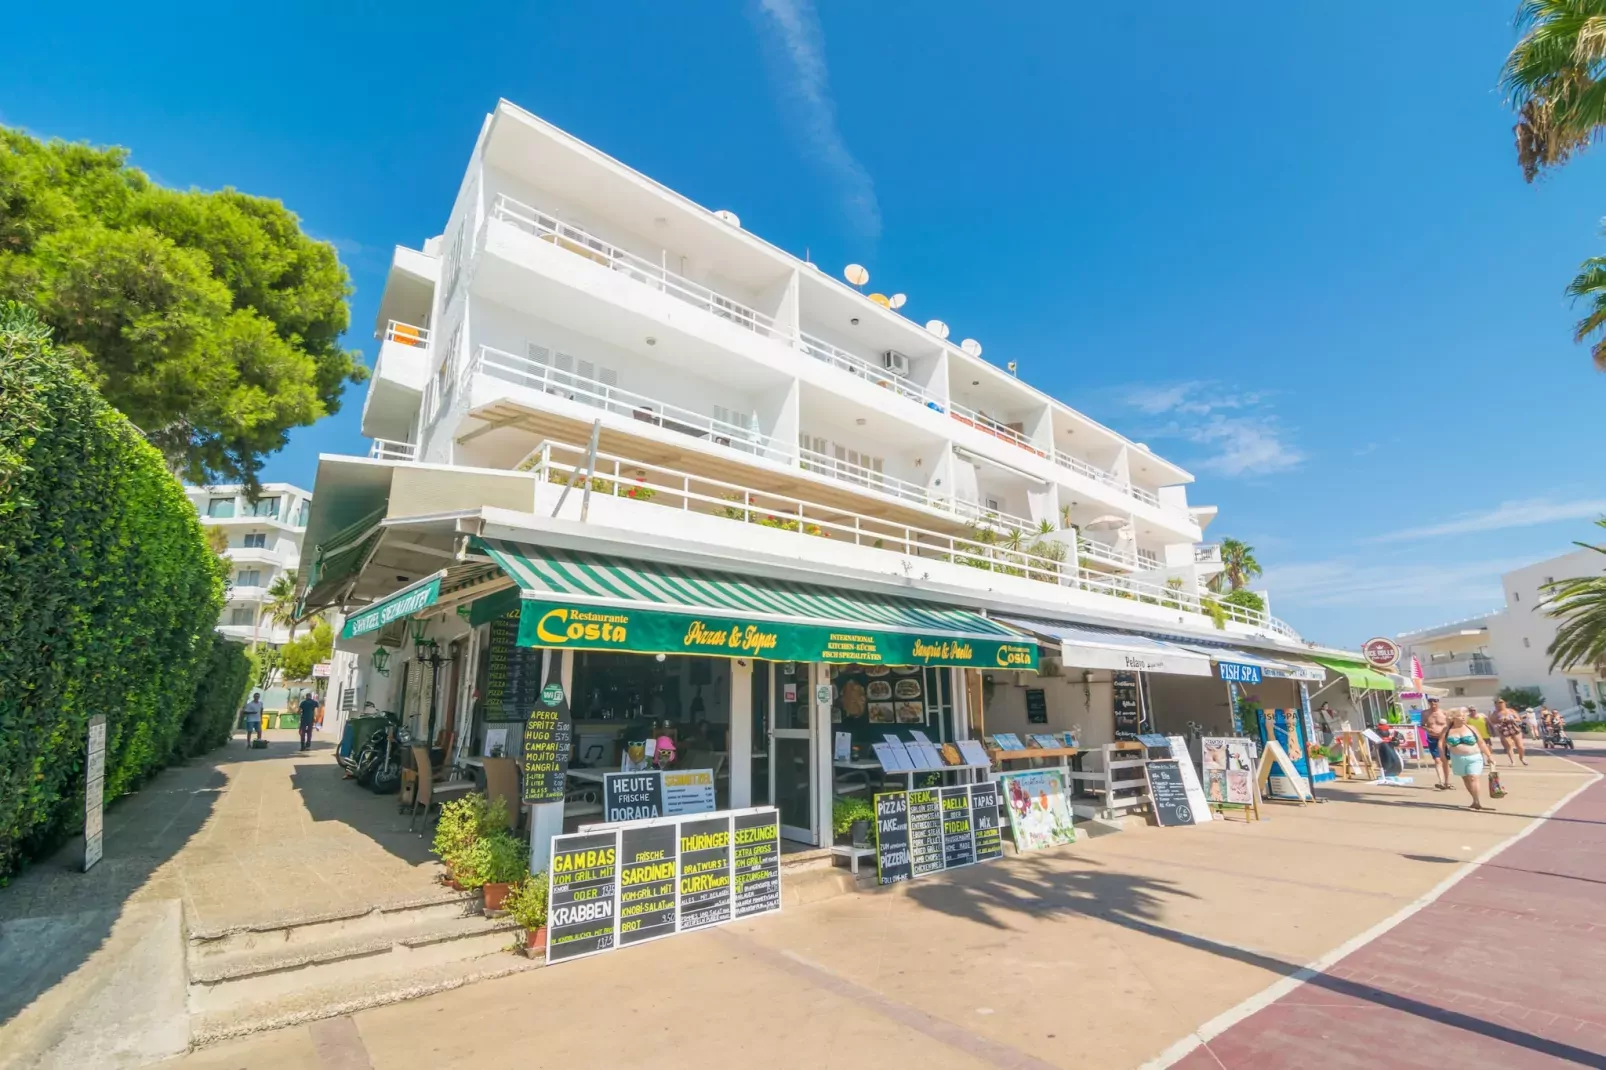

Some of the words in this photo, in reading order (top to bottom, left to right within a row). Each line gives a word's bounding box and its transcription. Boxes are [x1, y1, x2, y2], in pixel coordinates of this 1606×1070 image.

[570, 609, 629, 624] Restaurante
[536, 608, 627, 643] Costa
[684, 620, 727, 646] Pizzas
[728, 625, 741, 648] &
[742, 625, 777, 655] Tapas
[830, 633, 875, 644] INTERNATIONAL
[822, 650, 842, 659] FISCH
[912, 639, 940, 663] Sangria
[950, 641, 972, 660] Paella
[996, 645, 1031, 666] Costa
[1220, 663, 1240, 680] FISH
[1241, 666, 1259, 682] SPA
[531, 711, 559, 719] APEROL
[528, 721, 555, 730] SPRITZ
[526, 732, 550, 740] HUGO
[525, 742, 558, 751] CAMPARI
[526, 752, 555, 761] MOJITO
[525, 762, 560, 772] SANGRIA
[613, 777, 654, 793] HEUTE
[618, 793, 650, 803] FRISCHE
[909, 791, 931, 804] STEAK
[942, 797, 968, 811] PAELLA
[973, 795, 994, 807] TAPAS
[611, 804, 659, 822] DORADA
[877, 800, 907, 816] PIZZAS
[878, 818, 898, 834] TAKE
[979, 816, 991, 829] MIX
[734, 824, 778, 845] SEEZUNGEN
[681, 831, 730, 853] THÜRINGER
[635, 850, 665, 863] FRISCHE
[735, 848, 753, 858] EXTRA
[753, 844, 771, 855] GROSS
[553, 848, 615, 872] GAMBAS
[684, 859, 727, 875] BRATWURST
[553, 874, 571, 885] VOM
[574, 871, 597, 881] GRILL
[599, 866, 614, 877] MIT
[622, 862, 676, 886] SARDINEN
[573, 888, 597, 901] ODER
[660, 883, 673, 894] MIT
[551, 900, 612, 927] KRABBEN
[621, 919, 641, 932] BROT
